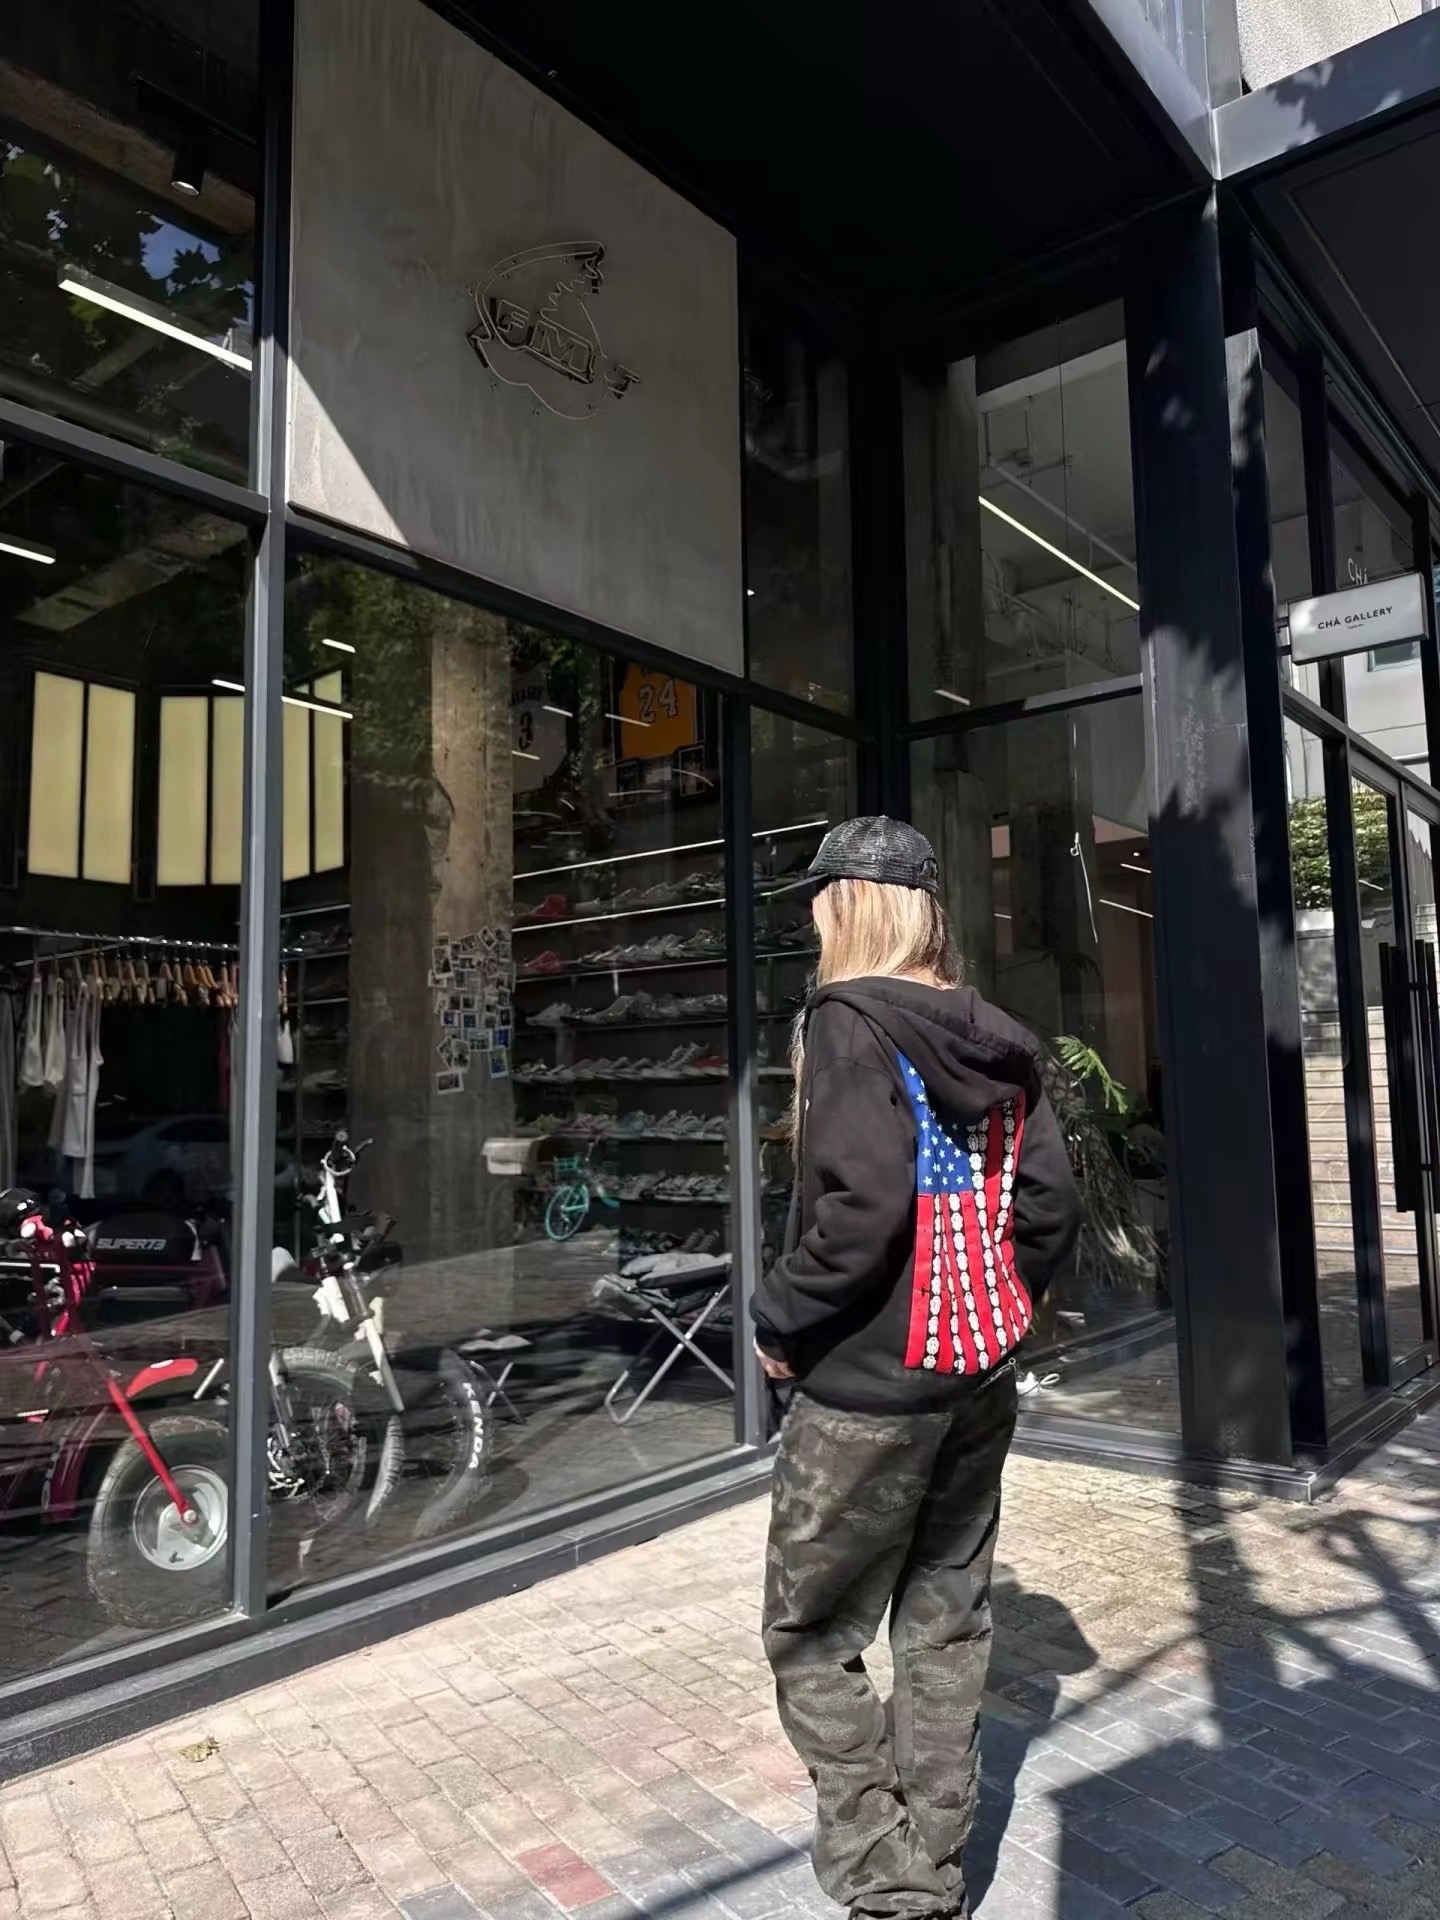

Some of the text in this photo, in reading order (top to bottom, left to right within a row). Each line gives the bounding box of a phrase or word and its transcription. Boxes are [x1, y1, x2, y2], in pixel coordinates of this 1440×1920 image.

[1344, 606, 1392, 624] GALLERY
[639, 678, 678, 723] 24
[519, 712, 532, 750] 3
[96, 1238, 167, 1250] SUPER73
[462, 1382, 484, 1469] KENDA
